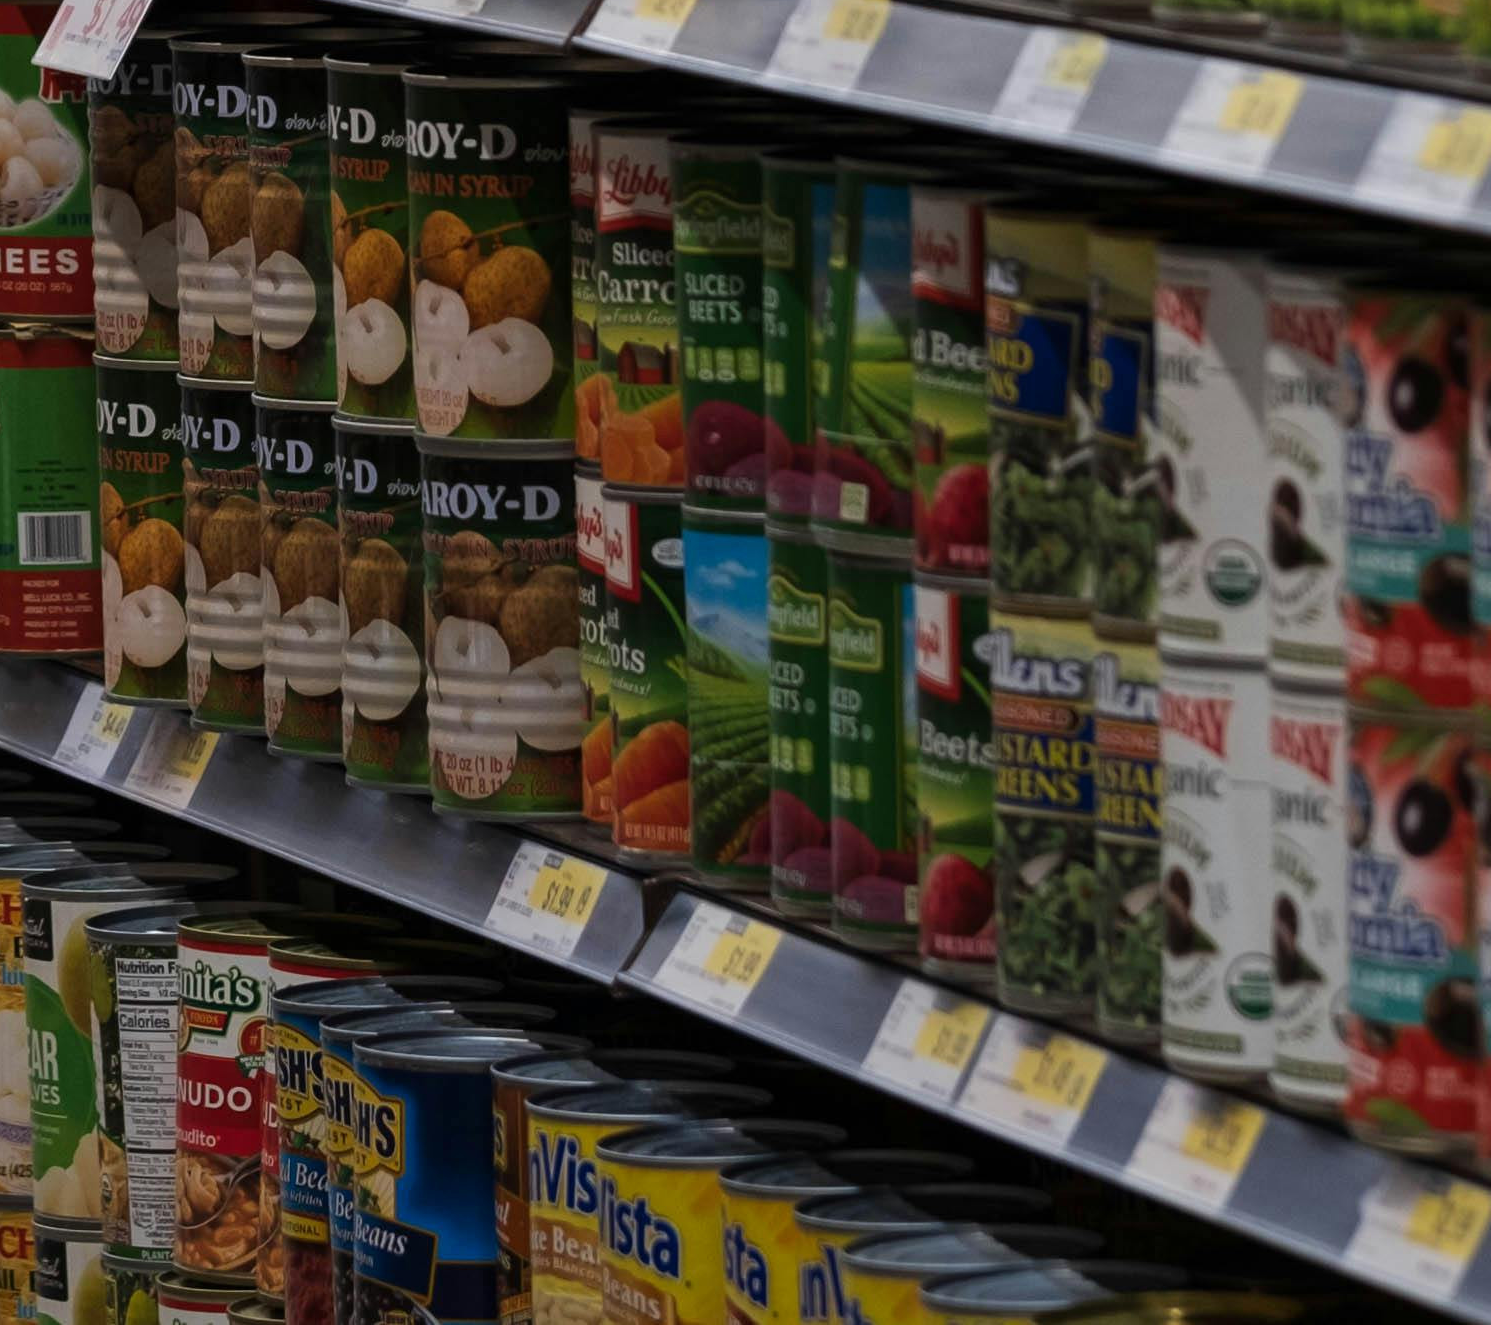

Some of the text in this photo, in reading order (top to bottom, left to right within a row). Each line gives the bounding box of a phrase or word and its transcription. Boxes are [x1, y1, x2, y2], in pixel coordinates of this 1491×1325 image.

[175, 82, 247, 119] OY-D
[407, 119, 517, 161] ROY-D
[605, 154, 673, 207] Libby
[685, 271, 745, 296] SLICED
[688, 300, 743, 324] BEETS
[116, 451, 170, 475] SYRUP
[423, 481, 560, 521] AROY-D
[116, 959, 167, 976] Nutrition
[181, 964, 255, 1007] nita's
[118, 1015, 170, 1030] Calories
[189, 1011, 220, 1025] FOODS
[355, 1217, 408, 1255] Beans
[603, 1268, 661, 1321] Beans
